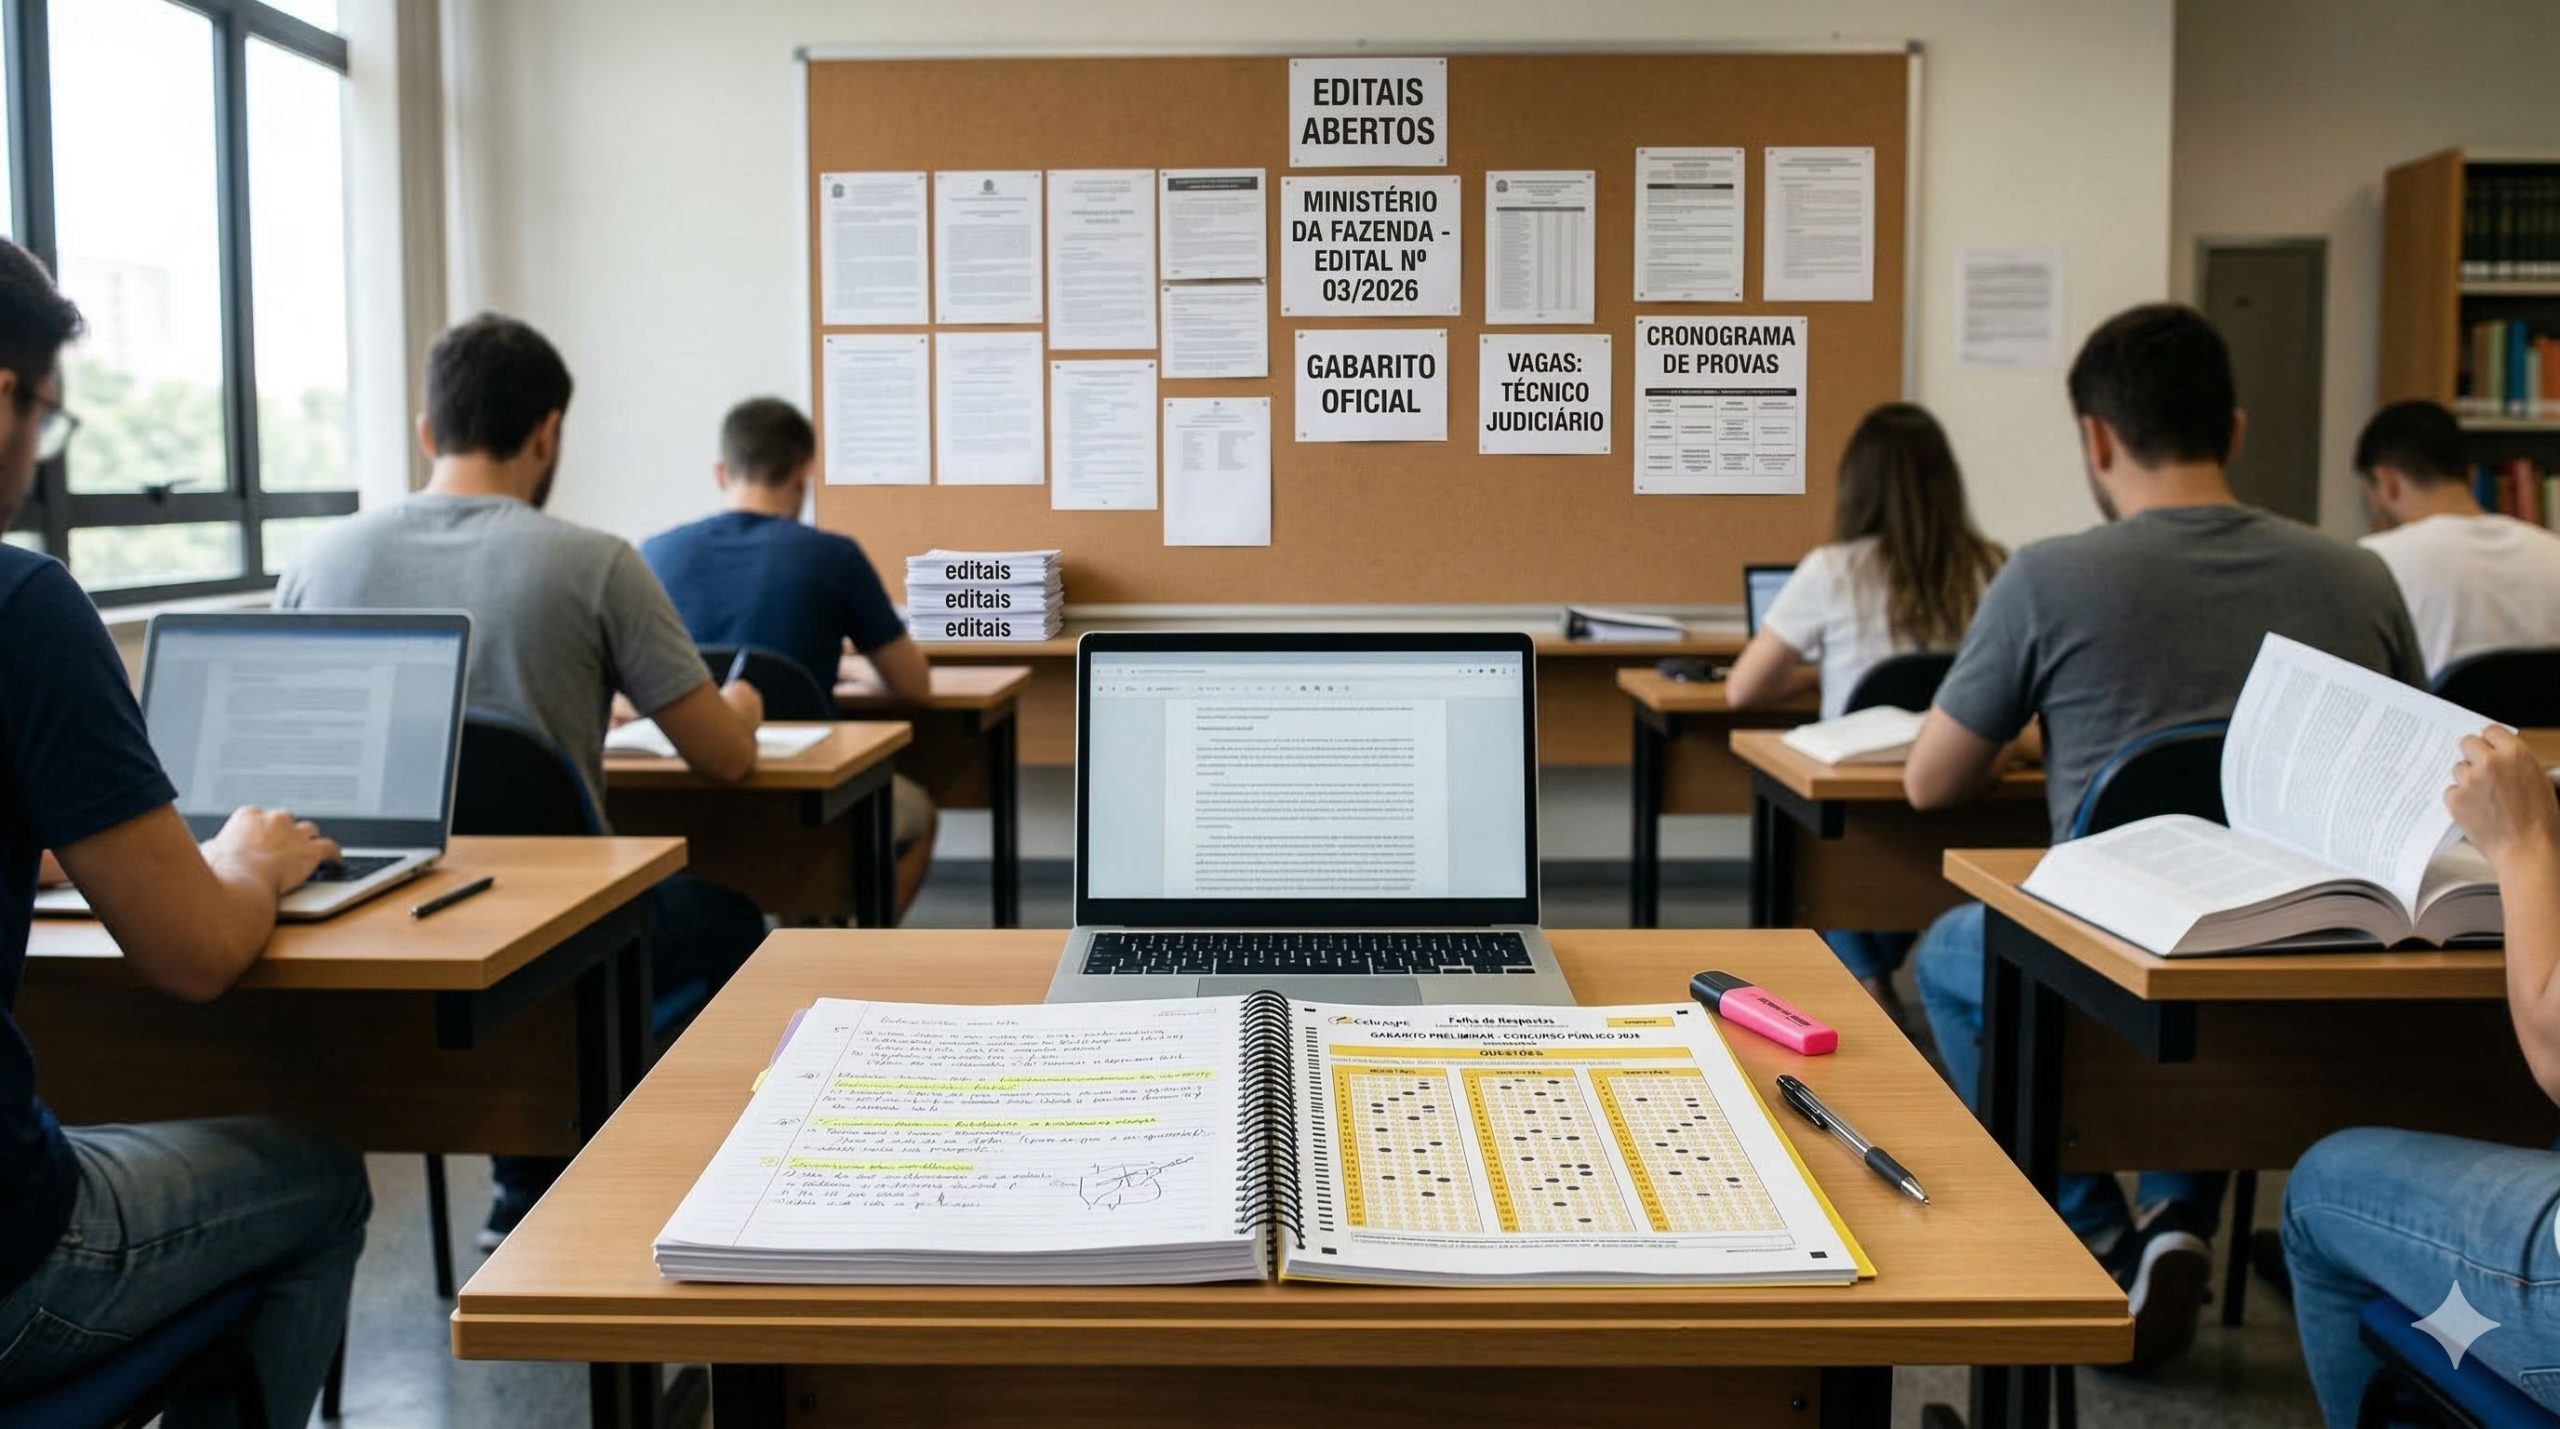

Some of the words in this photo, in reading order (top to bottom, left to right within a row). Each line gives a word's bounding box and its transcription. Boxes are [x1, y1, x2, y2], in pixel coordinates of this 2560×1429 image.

[1313, 77, 1424, 107] EDITAIS
[1301, 116, 1435, 145] ABERTOS
[1303, 185, 1438, 213] MINISTÉRIO
[1292, 220, 1323, 242] DA
[1331, 220, 1434, 242] FAZENDA
[1314, 248, 1393, 272] EDITAL
[1401, 248, 1427, 272] Nº
[1322, 278, 1419, 304] 03/2026
[1647, 325, 1796, 346] CRONOGRAMA
[1307, 353, 1436, 380] GABARITO
[1507, 352, 1582, 373] VAGAS:
[1663, 353, 1690, 374] DE
[1696, 353, 1779, 374] PROVAS
[1322, 388, 1421, 414] OFICIAL
[1501, 377, 1589, 403] TÉCNICO
[1486, 406, 1604, 432] JUDICIÁRIO
[945, 560, 1011, 580] editais
[945, 588, 1011, 609] editais
[945, 617, 1011, 637] editais
